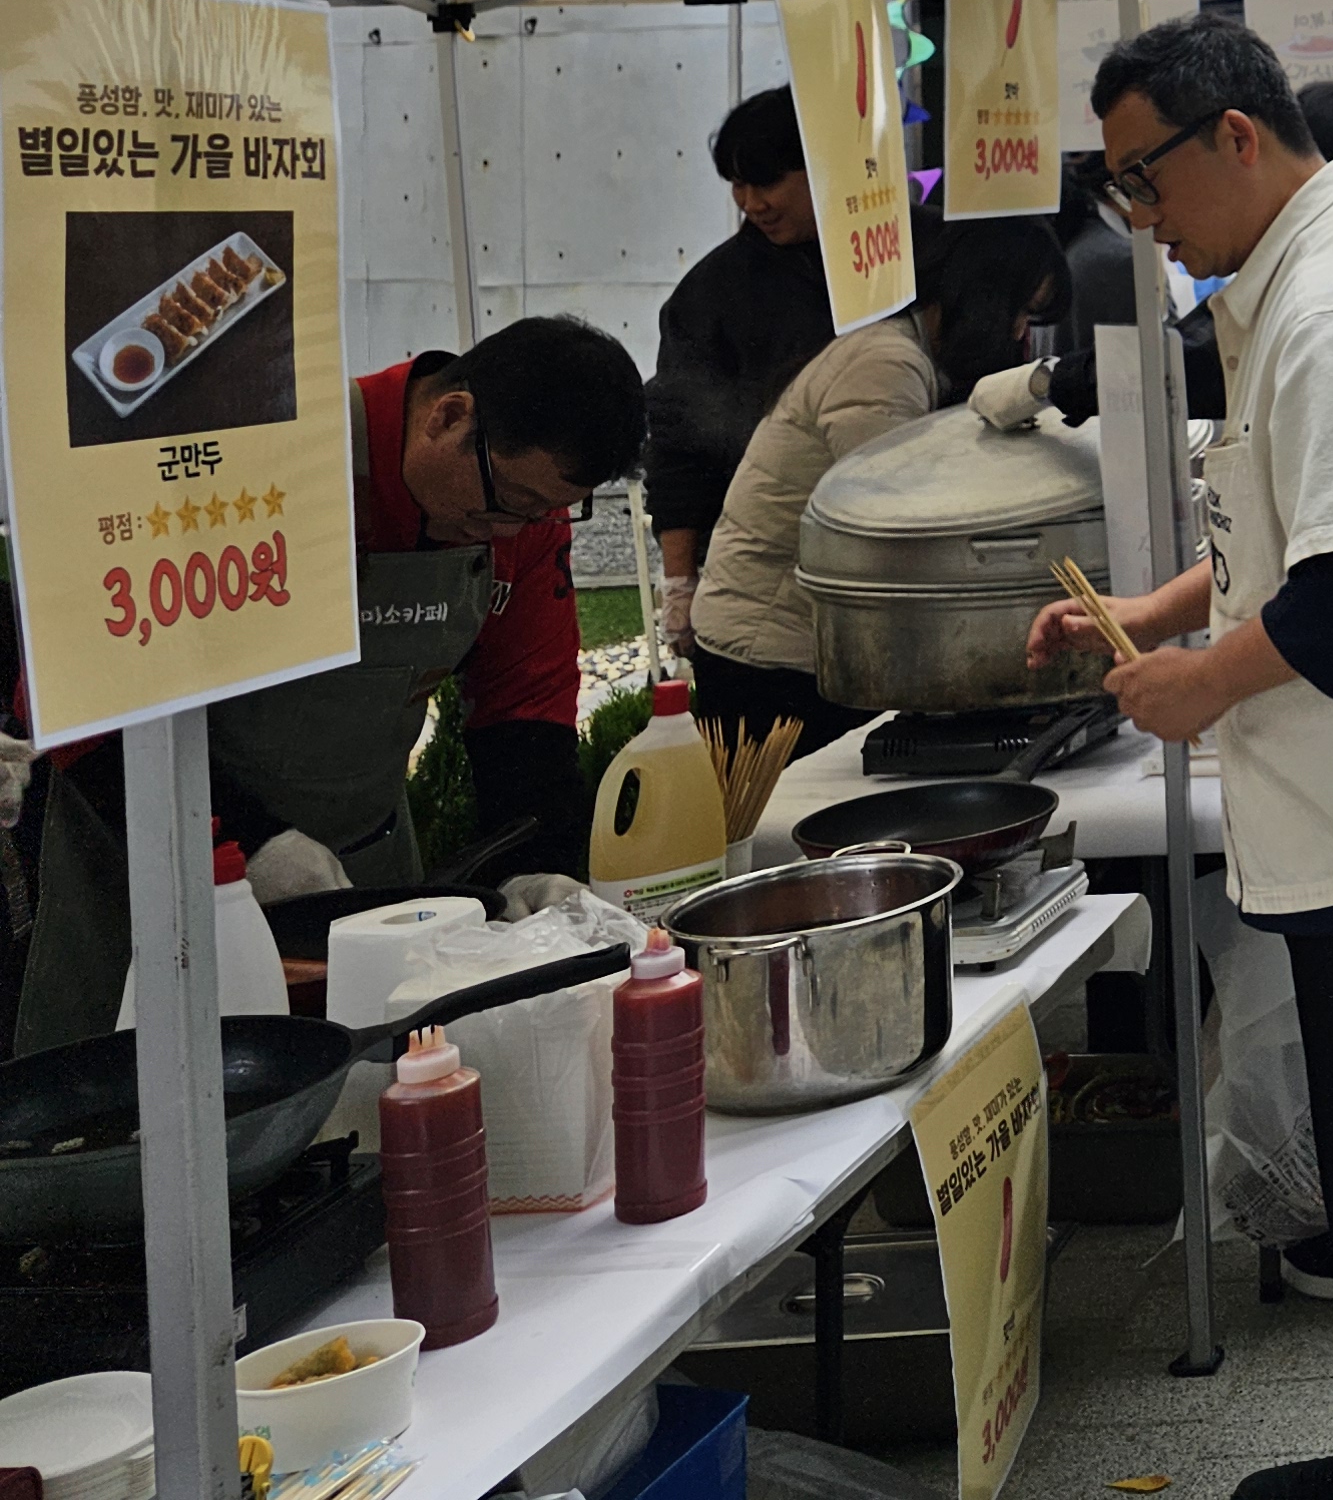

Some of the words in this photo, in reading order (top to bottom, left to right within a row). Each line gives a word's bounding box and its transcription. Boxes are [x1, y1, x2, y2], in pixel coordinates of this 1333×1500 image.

[77, 82, 148, 117] 풍성함,
[153, 88, 180, 119] 맛,
[185, 90, 243, 121] 재미가
[247, 94, 283, 123] 있는
[18, 126, 159, 178] 별일있는
[171, 133, 234, 179] 가을
[243, 136, 327, 180] 바자회
[975, 135, 1039, 180] 3,000원
[850, 215, 901, 279] 3,000원
[157, 441, 223, 482] 군만두
[103, 530, 291, 646] 3,000원
[936, 1150, 987, 1216] 별일있는
[986, 1119, 1012, 1162] 가을
